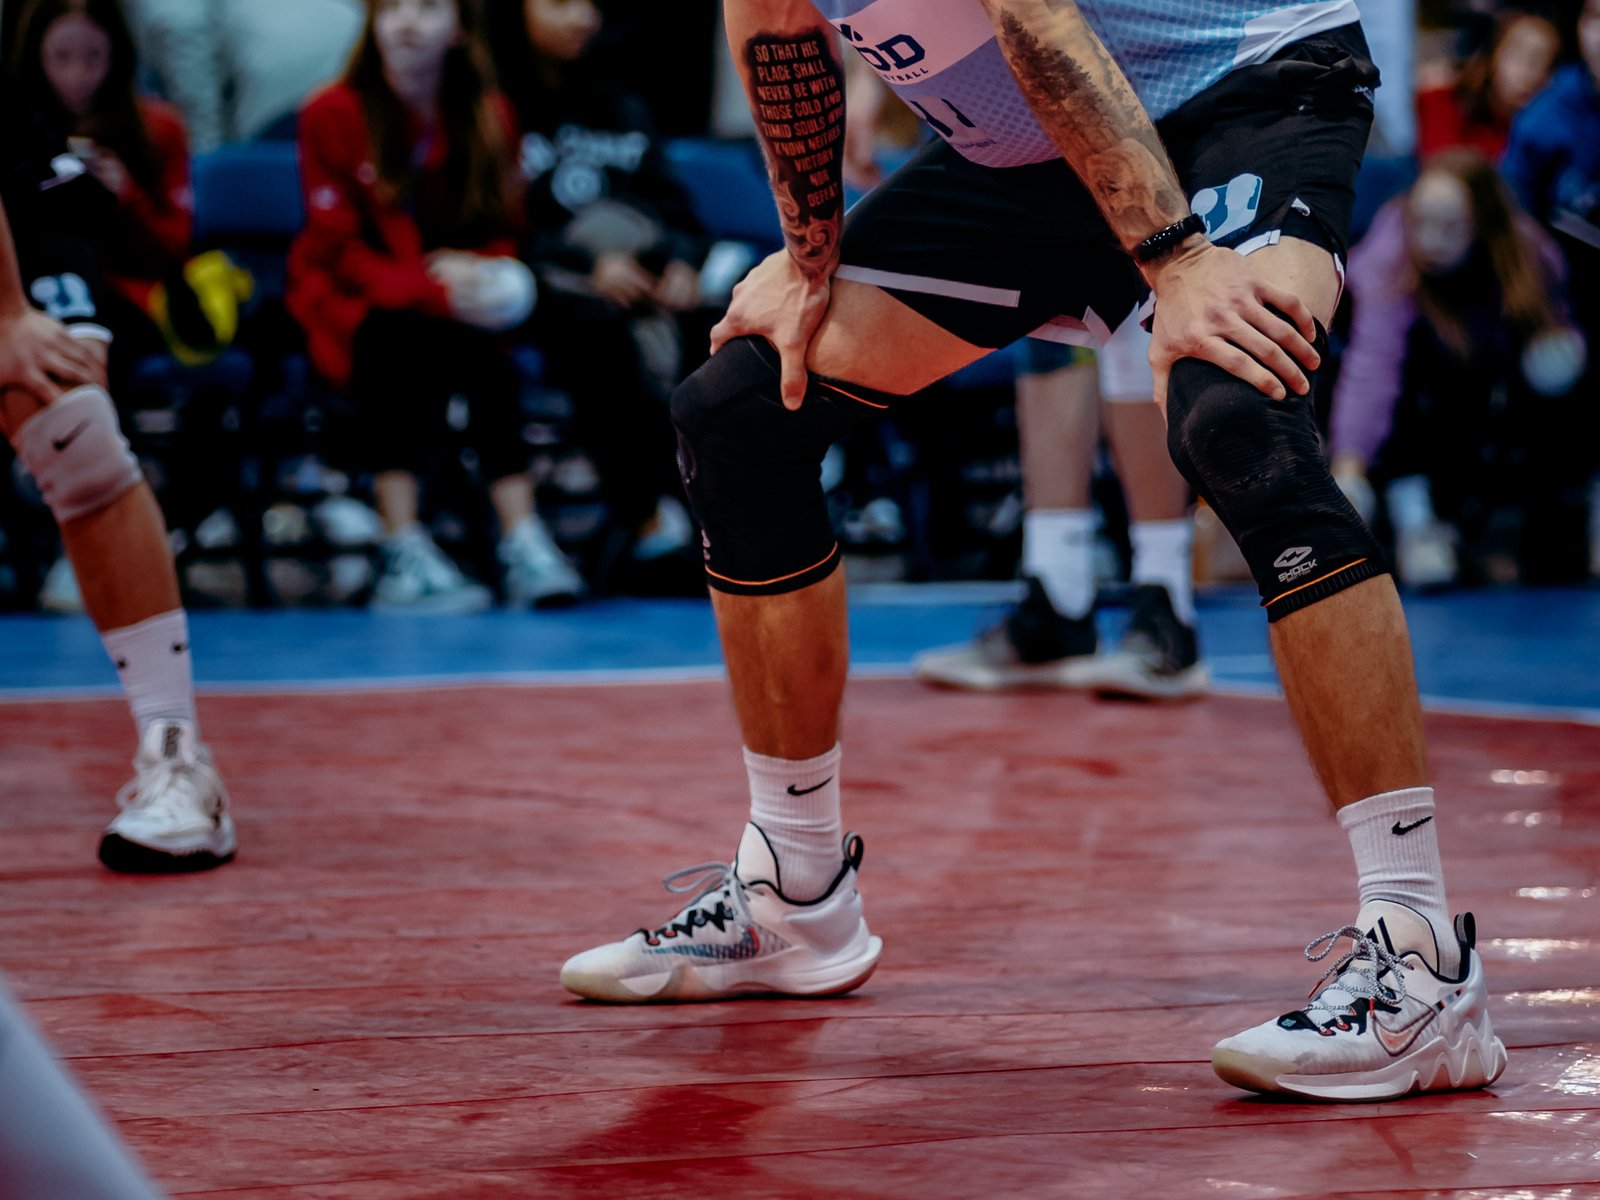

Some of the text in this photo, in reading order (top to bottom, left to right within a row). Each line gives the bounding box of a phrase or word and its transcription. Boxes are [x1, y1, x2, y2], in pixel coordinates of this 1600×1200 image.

[754, 40, 819, 63] SO THAT HIS
[757, 59, 826, 82] PLACE SHALL
[758, 75, 836, 101] NEVER BE WITH
[760, 91, 841, 119] THOSE COLD AND
[762, 122, 791, 137] TIMID
[794, 117, 826, 136] SOULS
[774, 141, 806, 156] KNOW
[795, 148, 834, 172] VICTORY
[809, 169, 830, 186] NOR
[808, 183, 838, 207] DEFEAT
[1278, 559, 1318, 583] SHOCK
